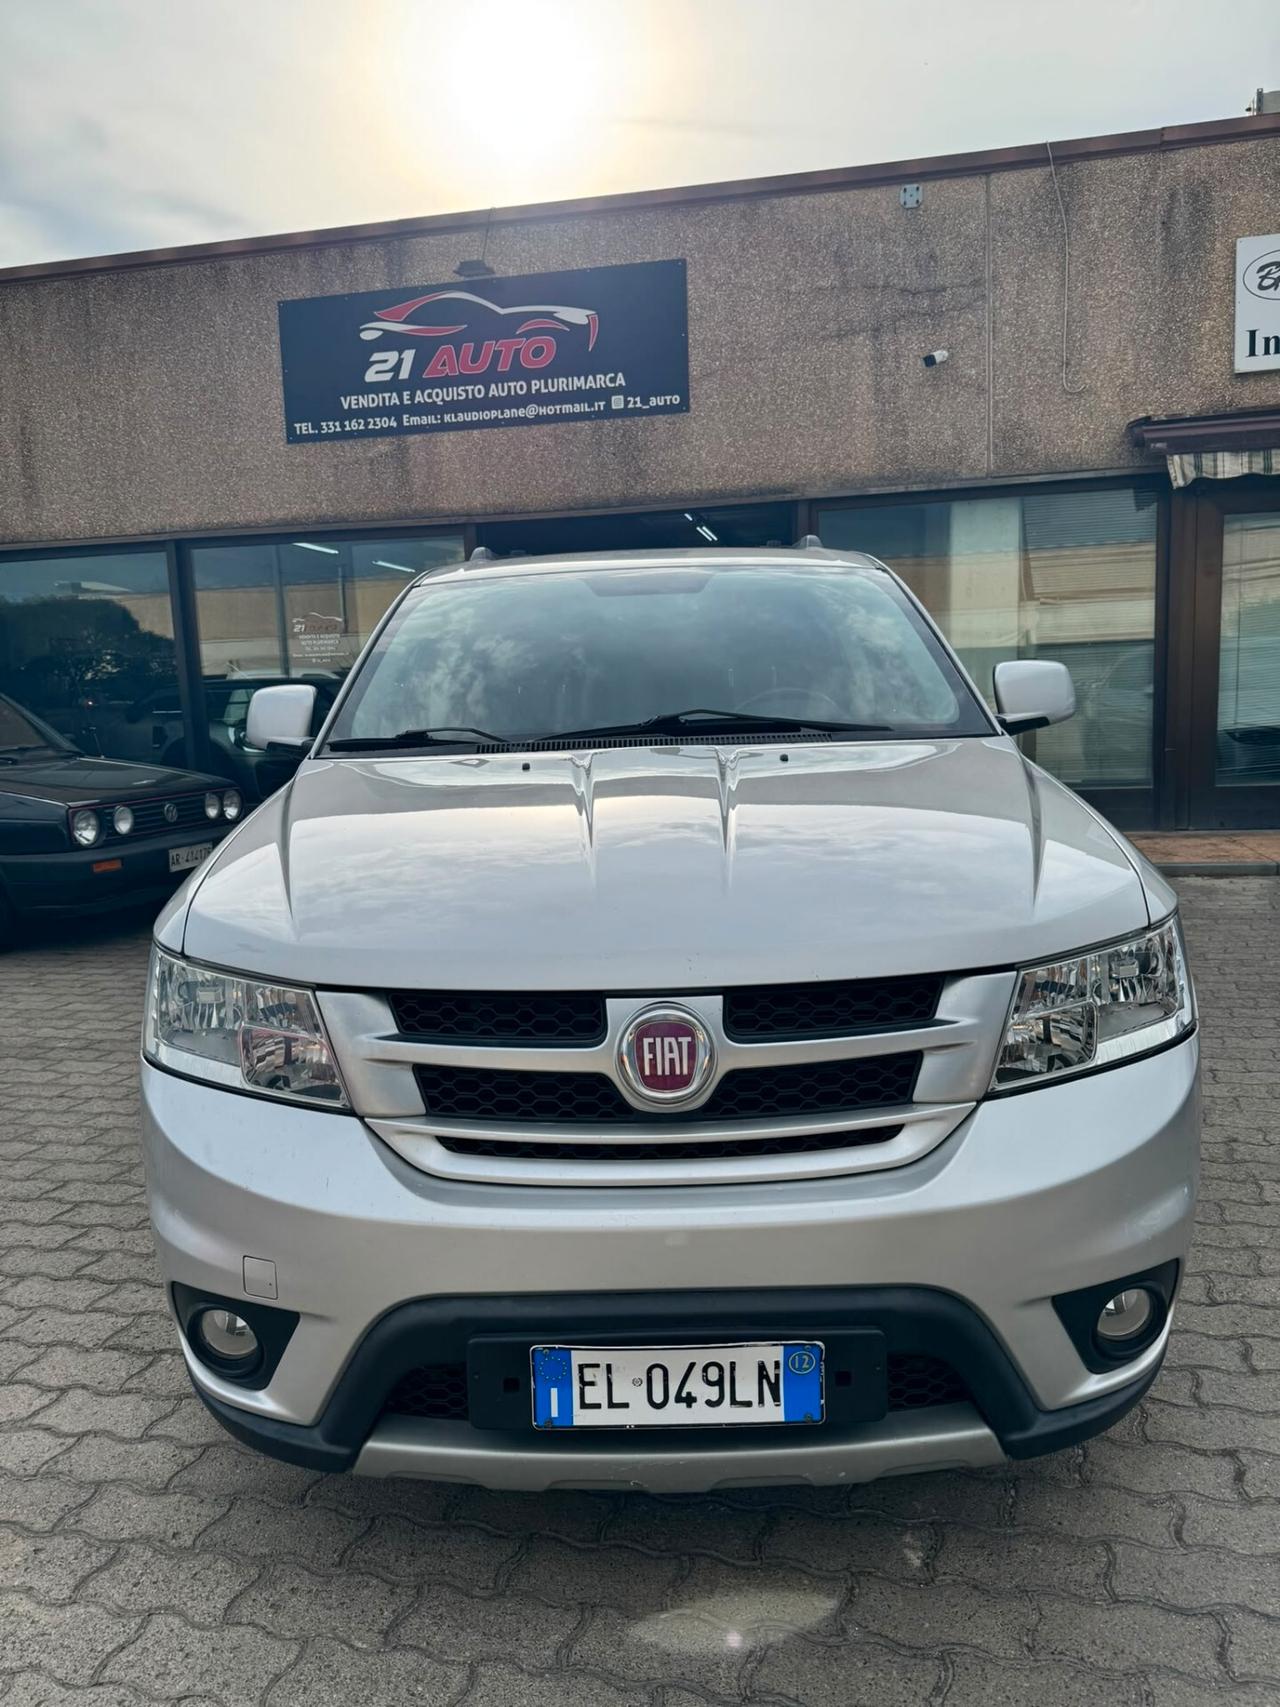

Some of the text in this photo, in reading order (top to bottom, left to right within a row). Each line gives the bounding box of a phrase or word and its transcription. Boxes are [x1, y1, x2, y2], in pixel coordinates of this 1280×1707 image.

[364, 336, 557, 382] 21 AUTO
[340, 372, 626, 410] VENDITA E ACQUISTO AUTO PLURIMARCA
[294, 422, 319, 435] TEL.
[320, 421, 342, 434] 331
[344, 419, 365, 432] 162
[367, 416, 398, 429] 2304
[643, 1036, 692, 1076] FIAT
[795, 1355, 810, 1369] 12
[577, 1360, 781, 1410] EL 049LN
